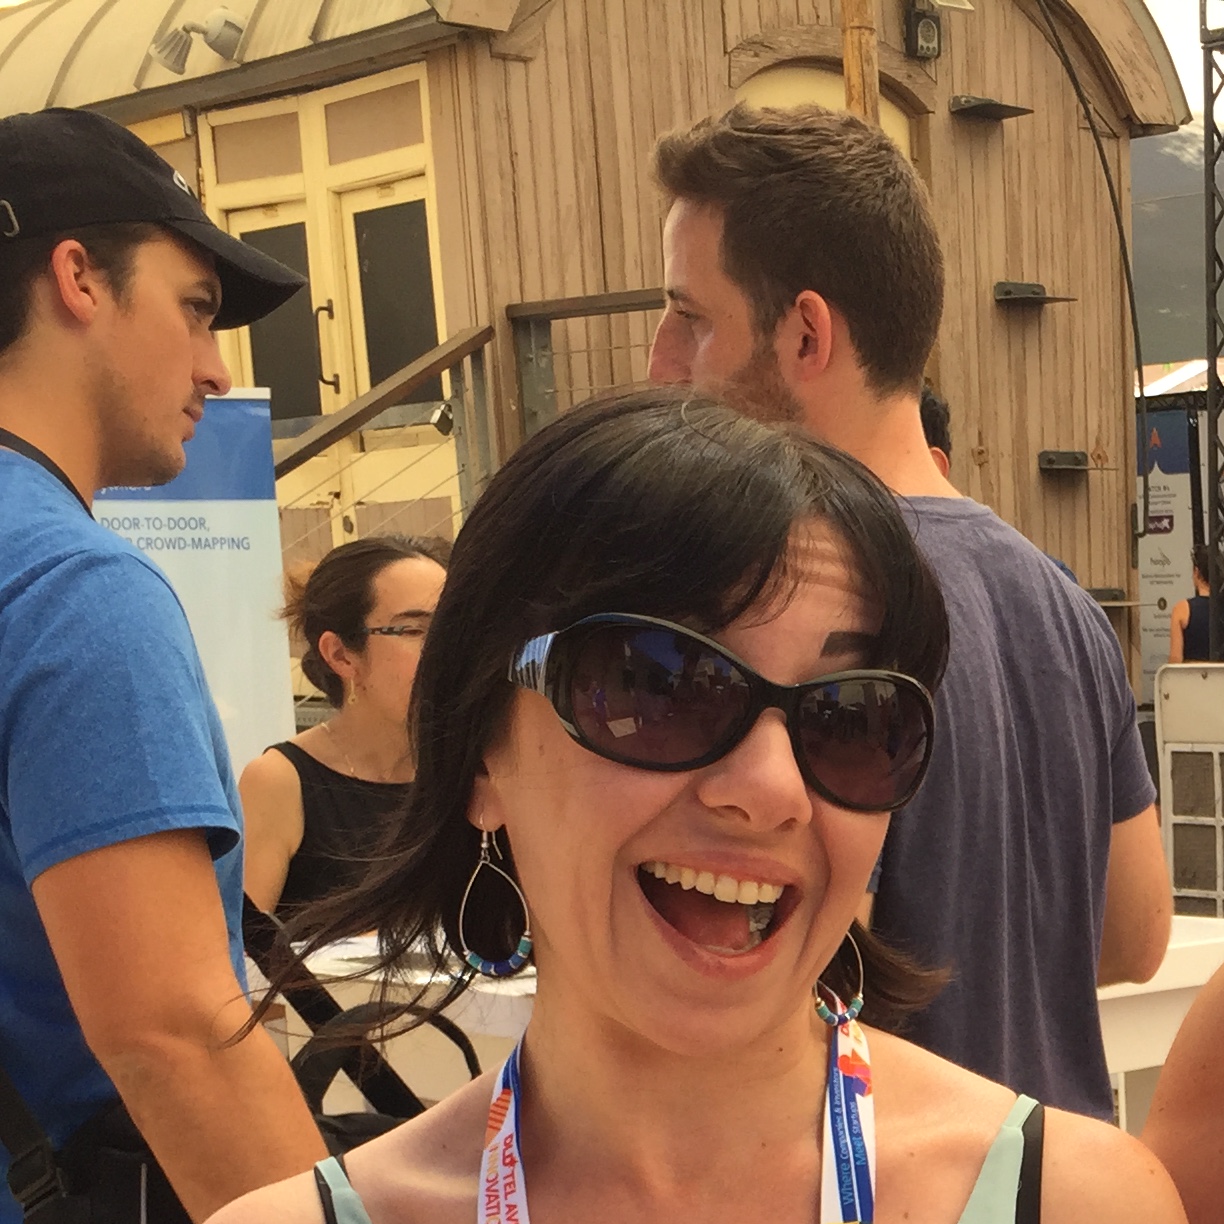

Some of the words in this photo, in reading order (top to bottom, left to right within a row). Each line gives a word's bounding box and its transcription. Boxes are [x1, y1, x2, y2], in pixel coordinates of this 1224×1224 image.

[136, 537, 251, 551] CROWD-MAPPING
[854, 1135, 868, 1167] Meet
[503, 1170, 516, 1201] TEL
[841, 1160, 853, 1206] Where
